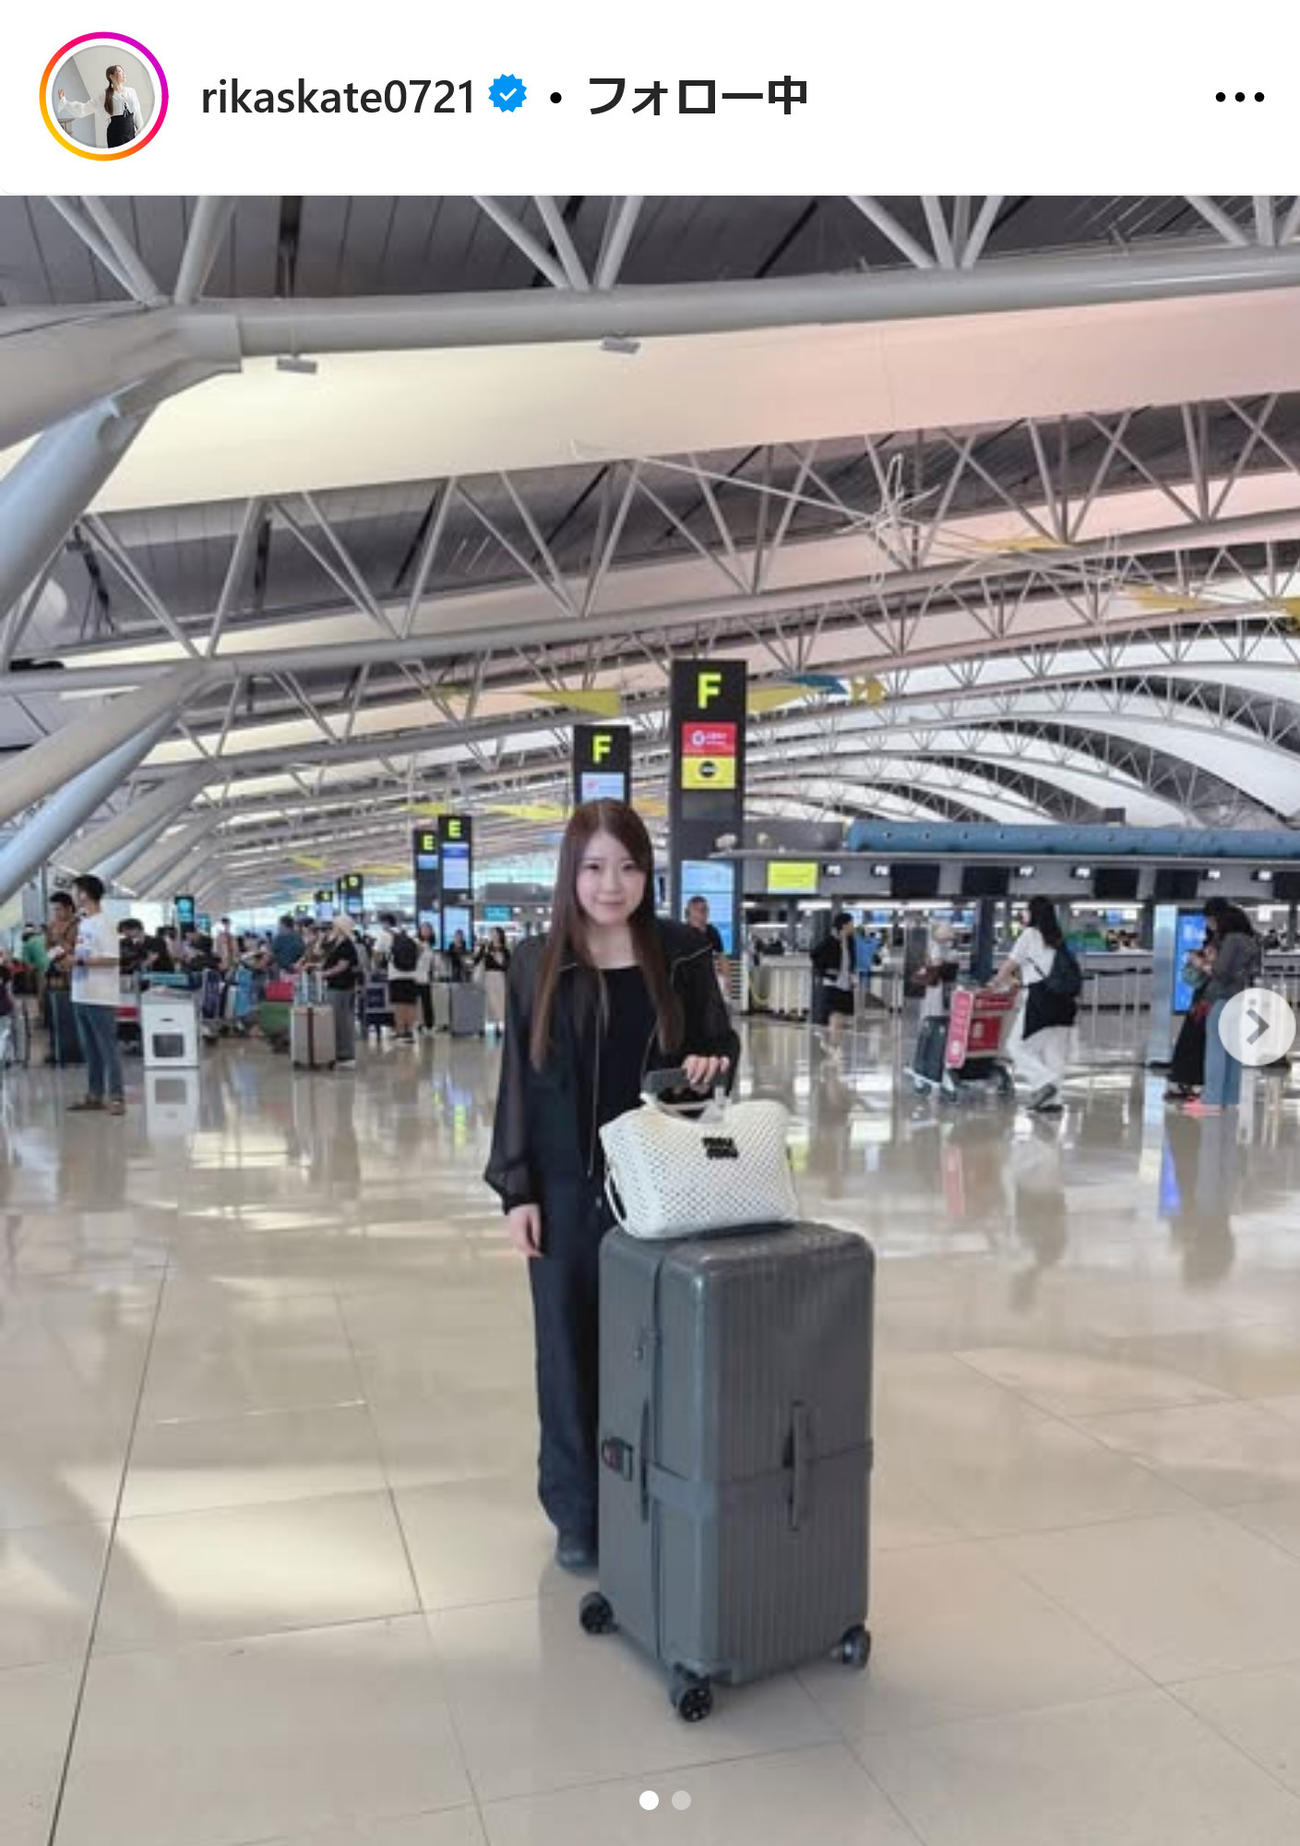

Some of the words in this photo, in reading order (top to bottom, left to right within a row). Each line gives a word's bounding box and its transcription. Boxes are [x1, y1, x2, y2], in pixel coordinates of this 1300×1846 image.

[697, 672, 722, 709] F
[592, 734, 612, 764] F
[448, 820, 462, 838] E
[422, 835, 435, 850] E
